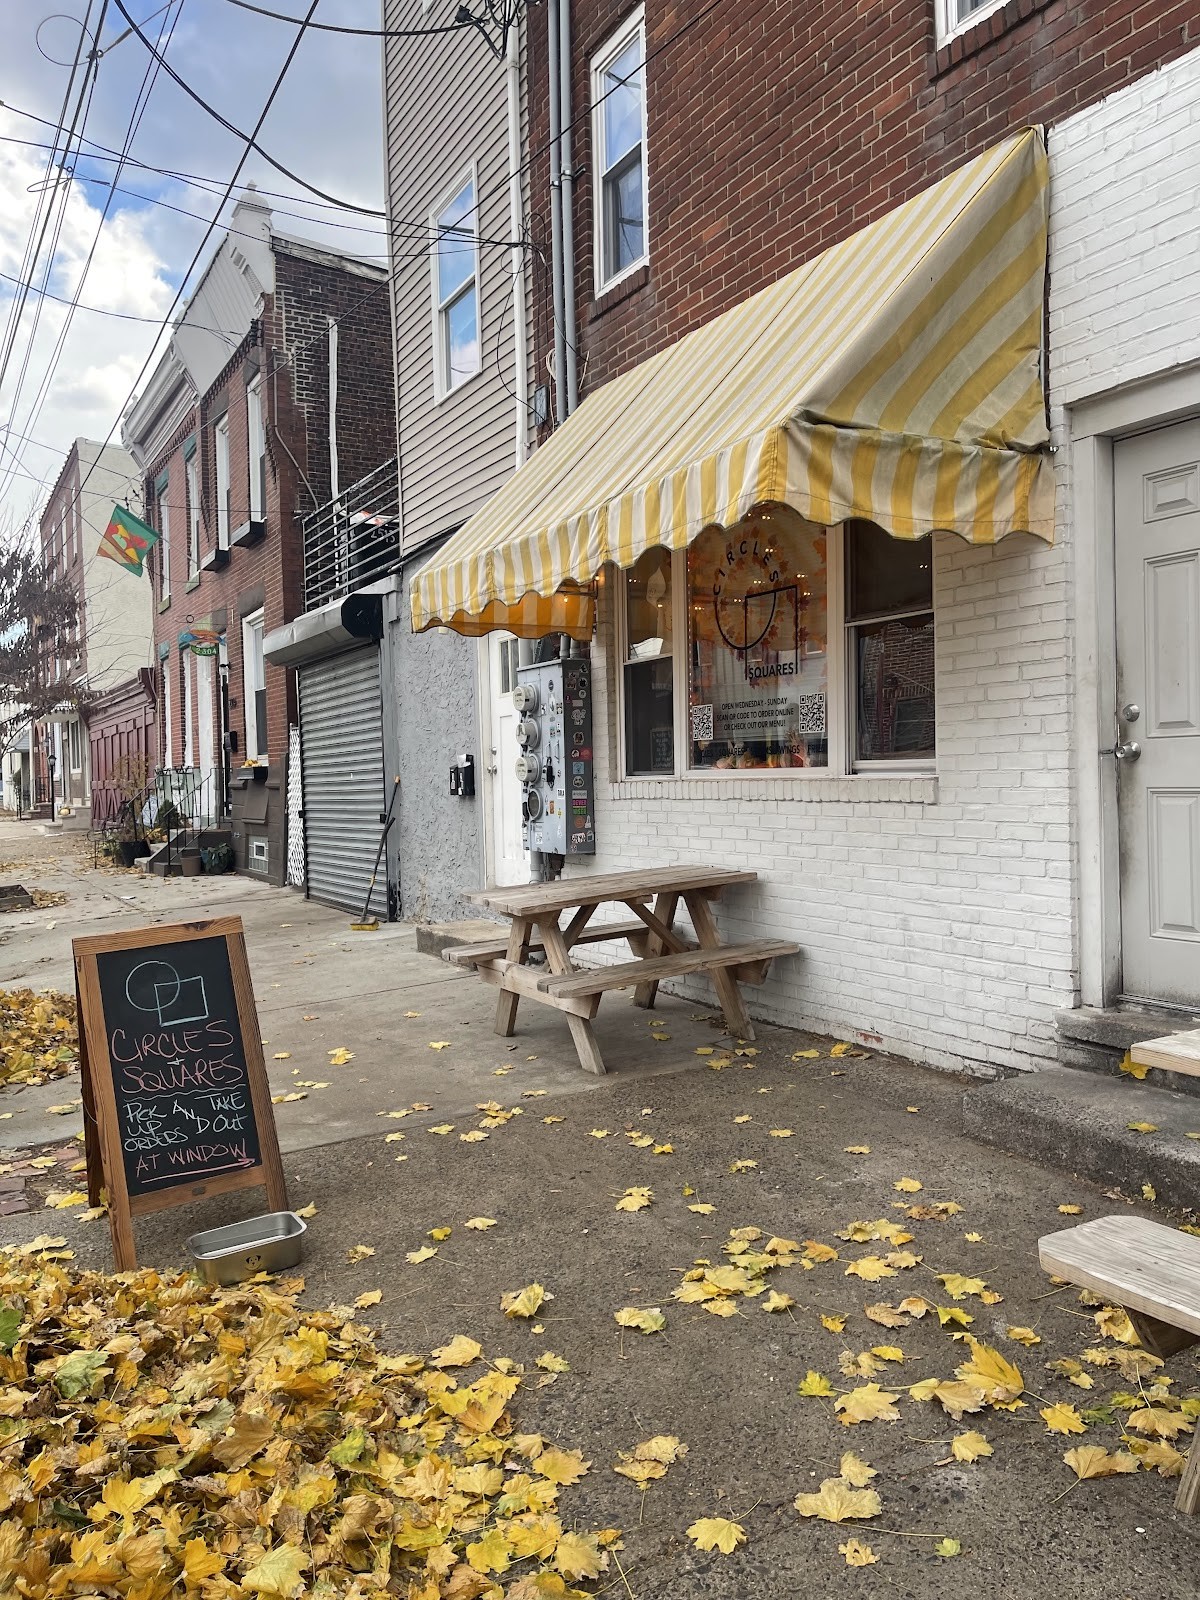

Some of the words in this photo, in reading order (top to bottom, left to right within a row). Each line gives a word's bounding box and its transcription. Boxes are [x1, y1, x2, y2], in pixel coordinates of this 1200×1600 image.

[713, 540, 779, 596] CIRCLES
[748, 662, 794, 679] SQUARES
[716, 714, 729, 722] SCAN
[736, 711, 750, 720] CODE
[750, 711, 757, 719] TO
[757, 709, 775, 718] ORDER
[775, 707, 794, 716] ONLINE
[721, 702, 734, 711] OPEN
[735, 699, 764, 709] WEDNESDAY
[767, 697, 788, 706] SUNDAY
[724, 723, 731, 731] OR
[731, 722, 746, 730] CHECK
[746, 721, 757, 729] OUT
[757, 720, 768, 729] OUR
[768, 719, 786, 728] MENU!
[111, 1019, 234, 1062] CIRCLES
[120, 1053, 244, 1094] SQUARES
[194, 1092, 246, 1111] TAKE
[123, 1102, 167, 1123] PICK
[173, 1099, 210, 1135] AND
[136, 1153, 161, 1178] AT
[168, 1138, 247, 1165] WINDOW
